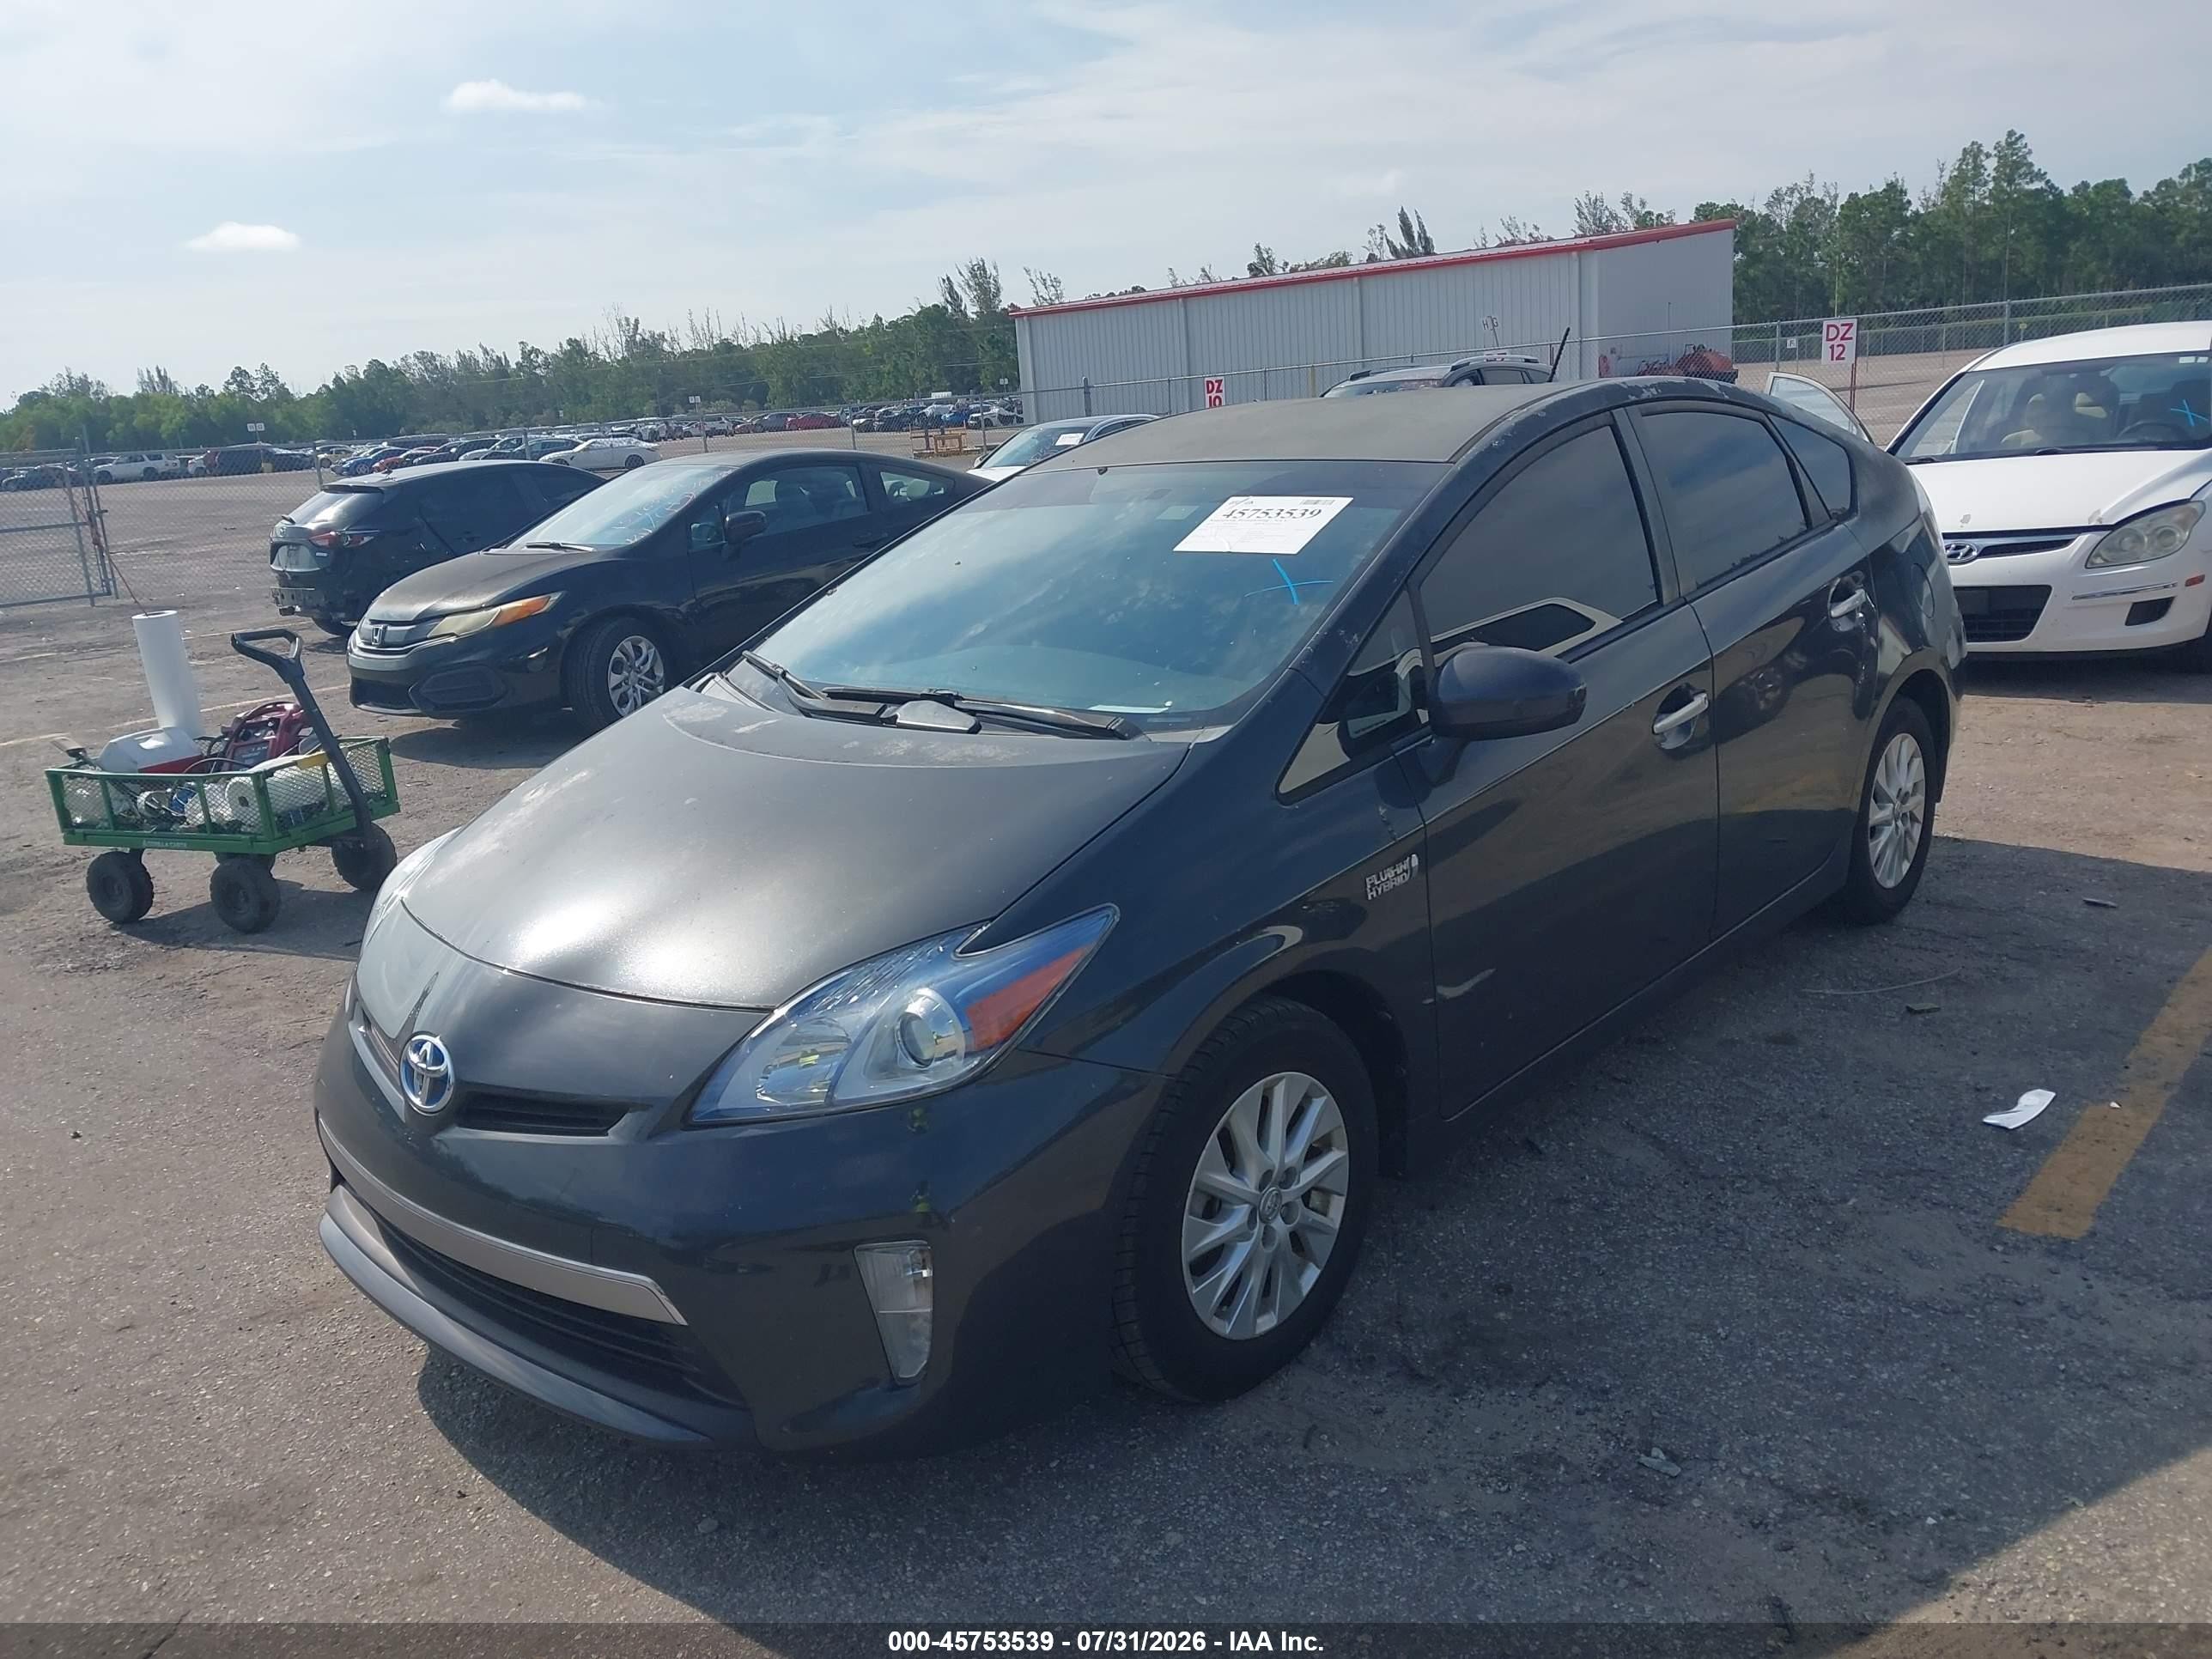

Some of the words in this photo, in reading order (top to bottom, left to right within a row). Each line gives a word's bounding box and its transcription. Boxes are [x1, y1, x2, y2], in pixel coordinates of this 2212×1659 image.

[1826, 322, 1854, 342] DZ
[1829, 344, 1846, 361] 12
[1206, 379, 1223, 394] DZ
[1222, 508, 1322, 520] 45753539
[1367, 872, 1409, 900] HYBRID
